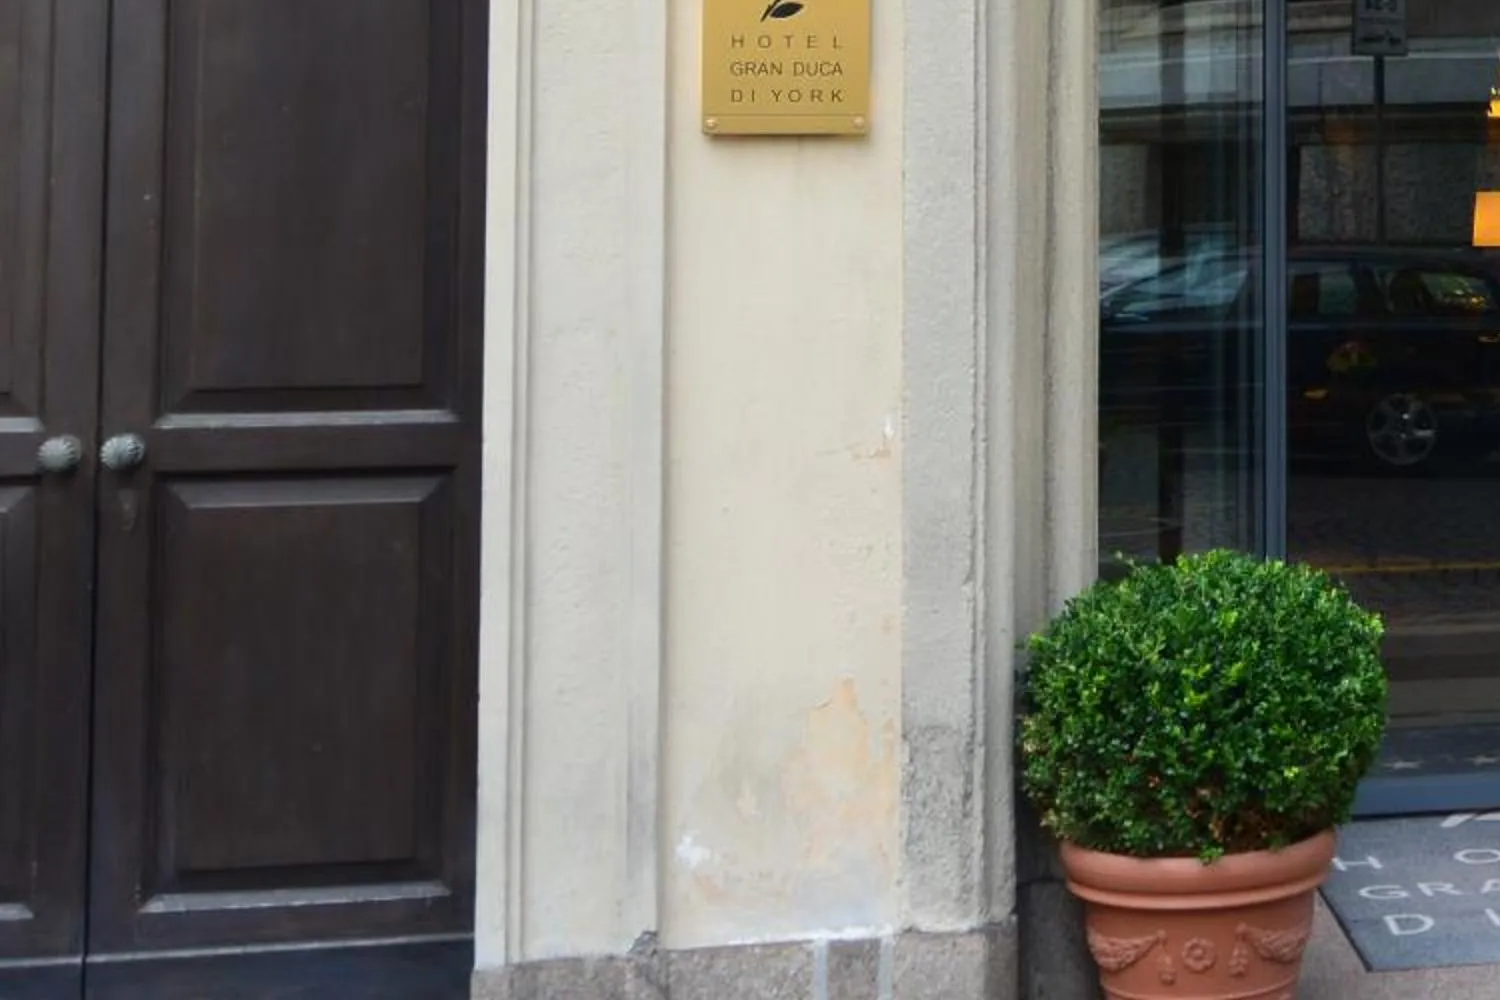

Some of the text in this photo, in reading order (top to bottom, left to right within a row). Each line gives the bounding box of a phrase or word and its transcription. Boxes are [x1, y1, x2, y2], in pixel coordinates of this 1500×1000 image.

[730, 34, 844, 49] HOTEL
[729, 61, 843, 77] GRAN DUCA
[731, 88, 843, 103] DI YORK
